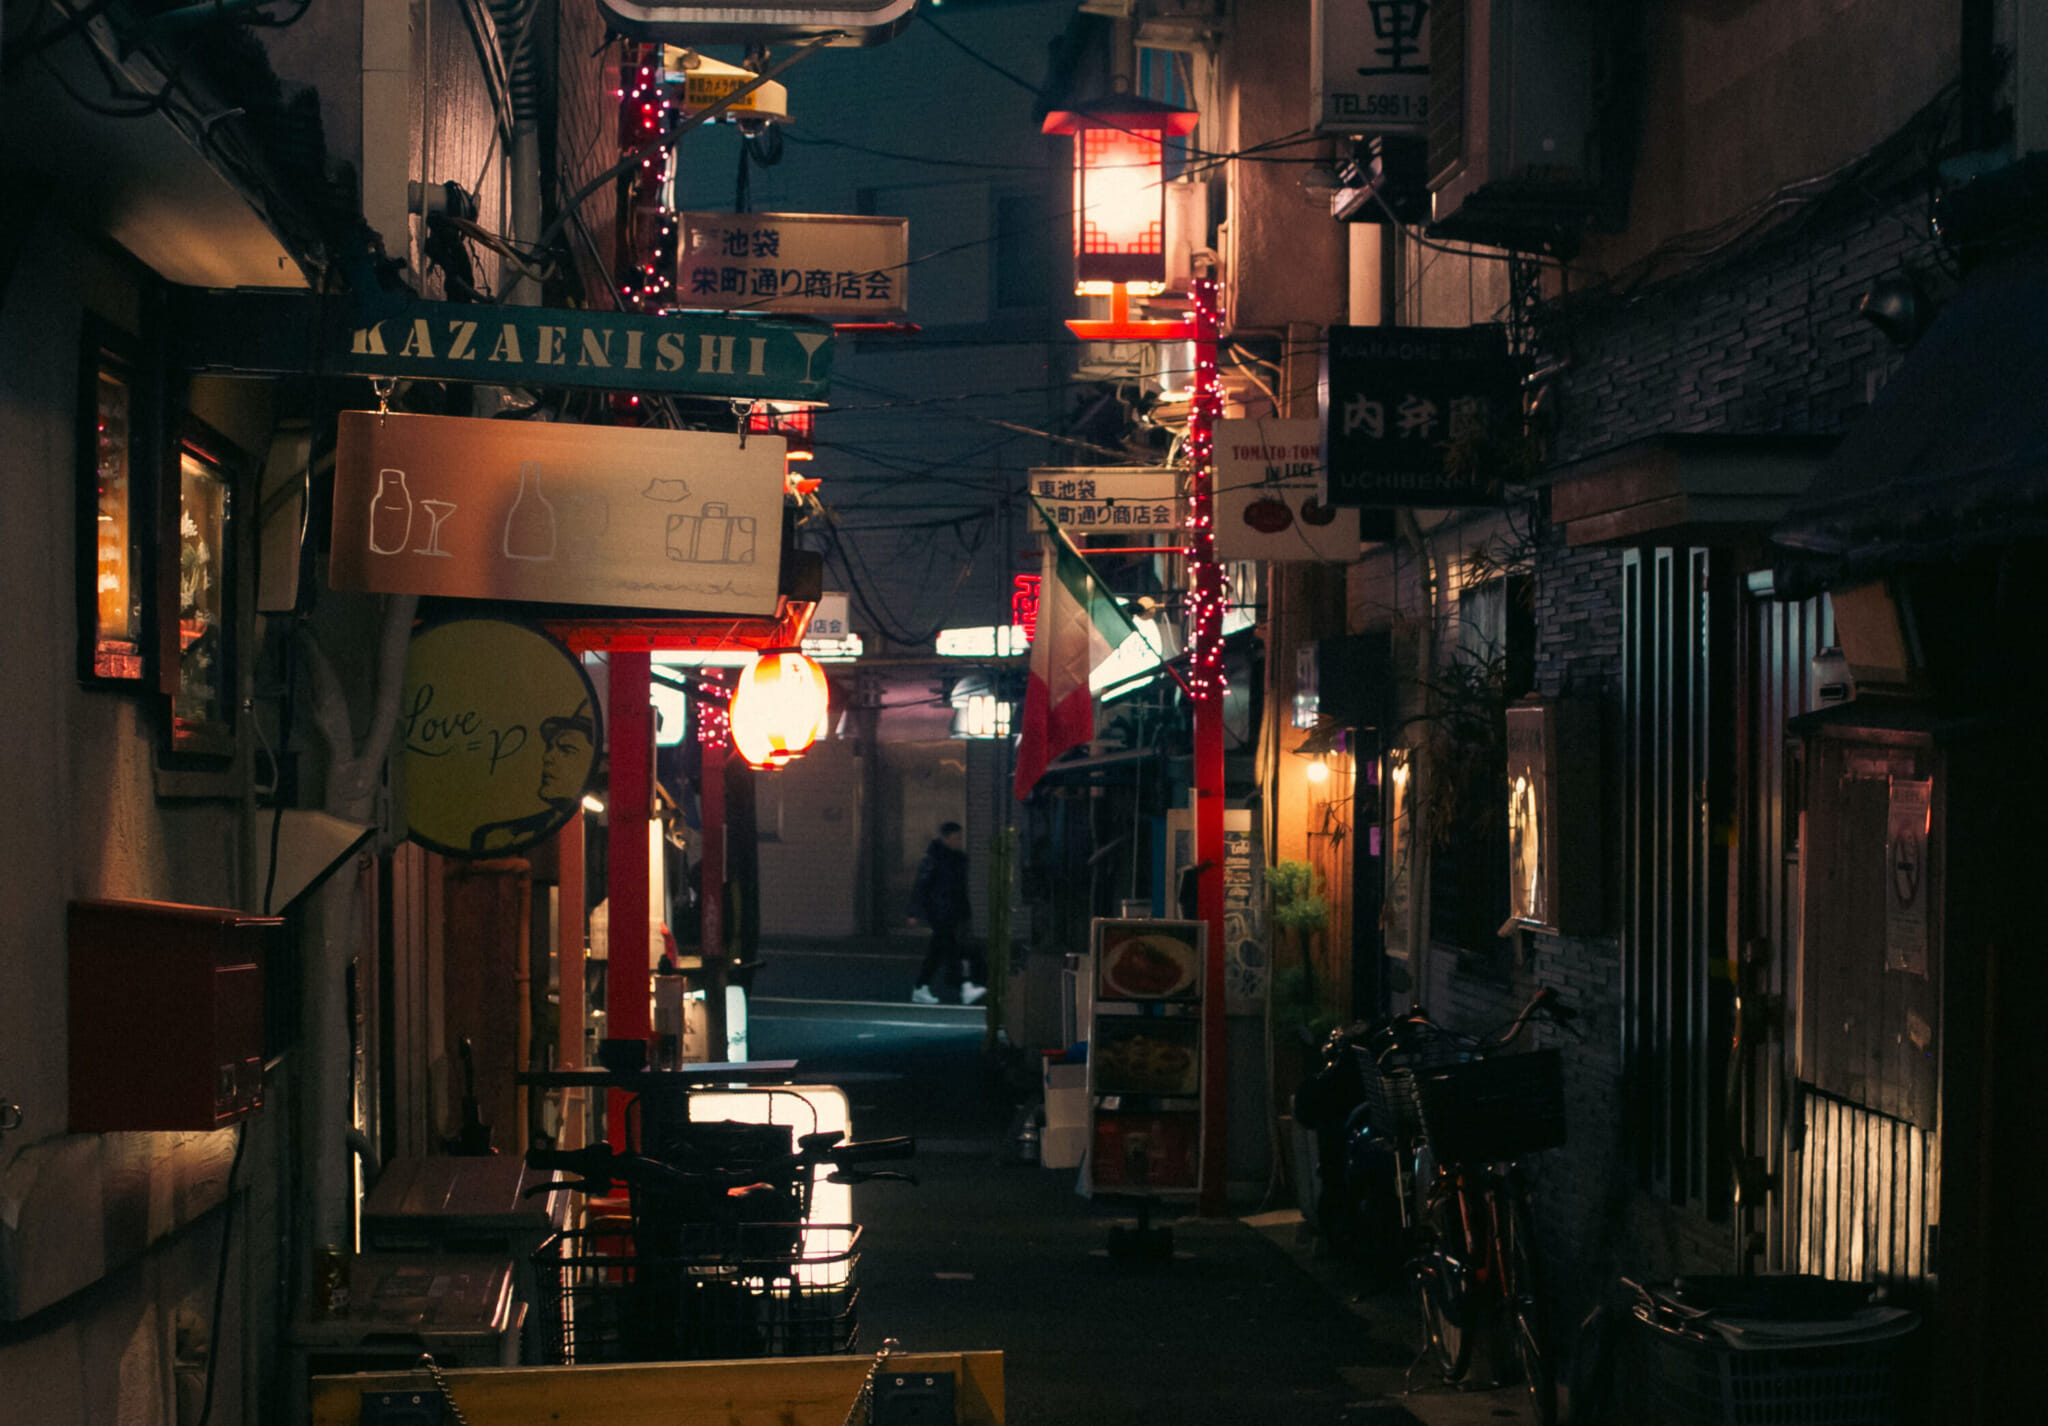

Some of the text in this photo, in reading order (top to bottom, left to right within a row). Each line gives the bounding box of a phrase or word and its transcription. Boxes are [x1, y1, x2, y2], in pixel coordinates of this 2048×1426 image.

[691, 266, 893, 301] 栄町通り商店会
[350, 317, 768, 377] KAZAENISHI
[1038, 479, 1096, 500] 東池袋
[404, 682, 482, 758] Love
